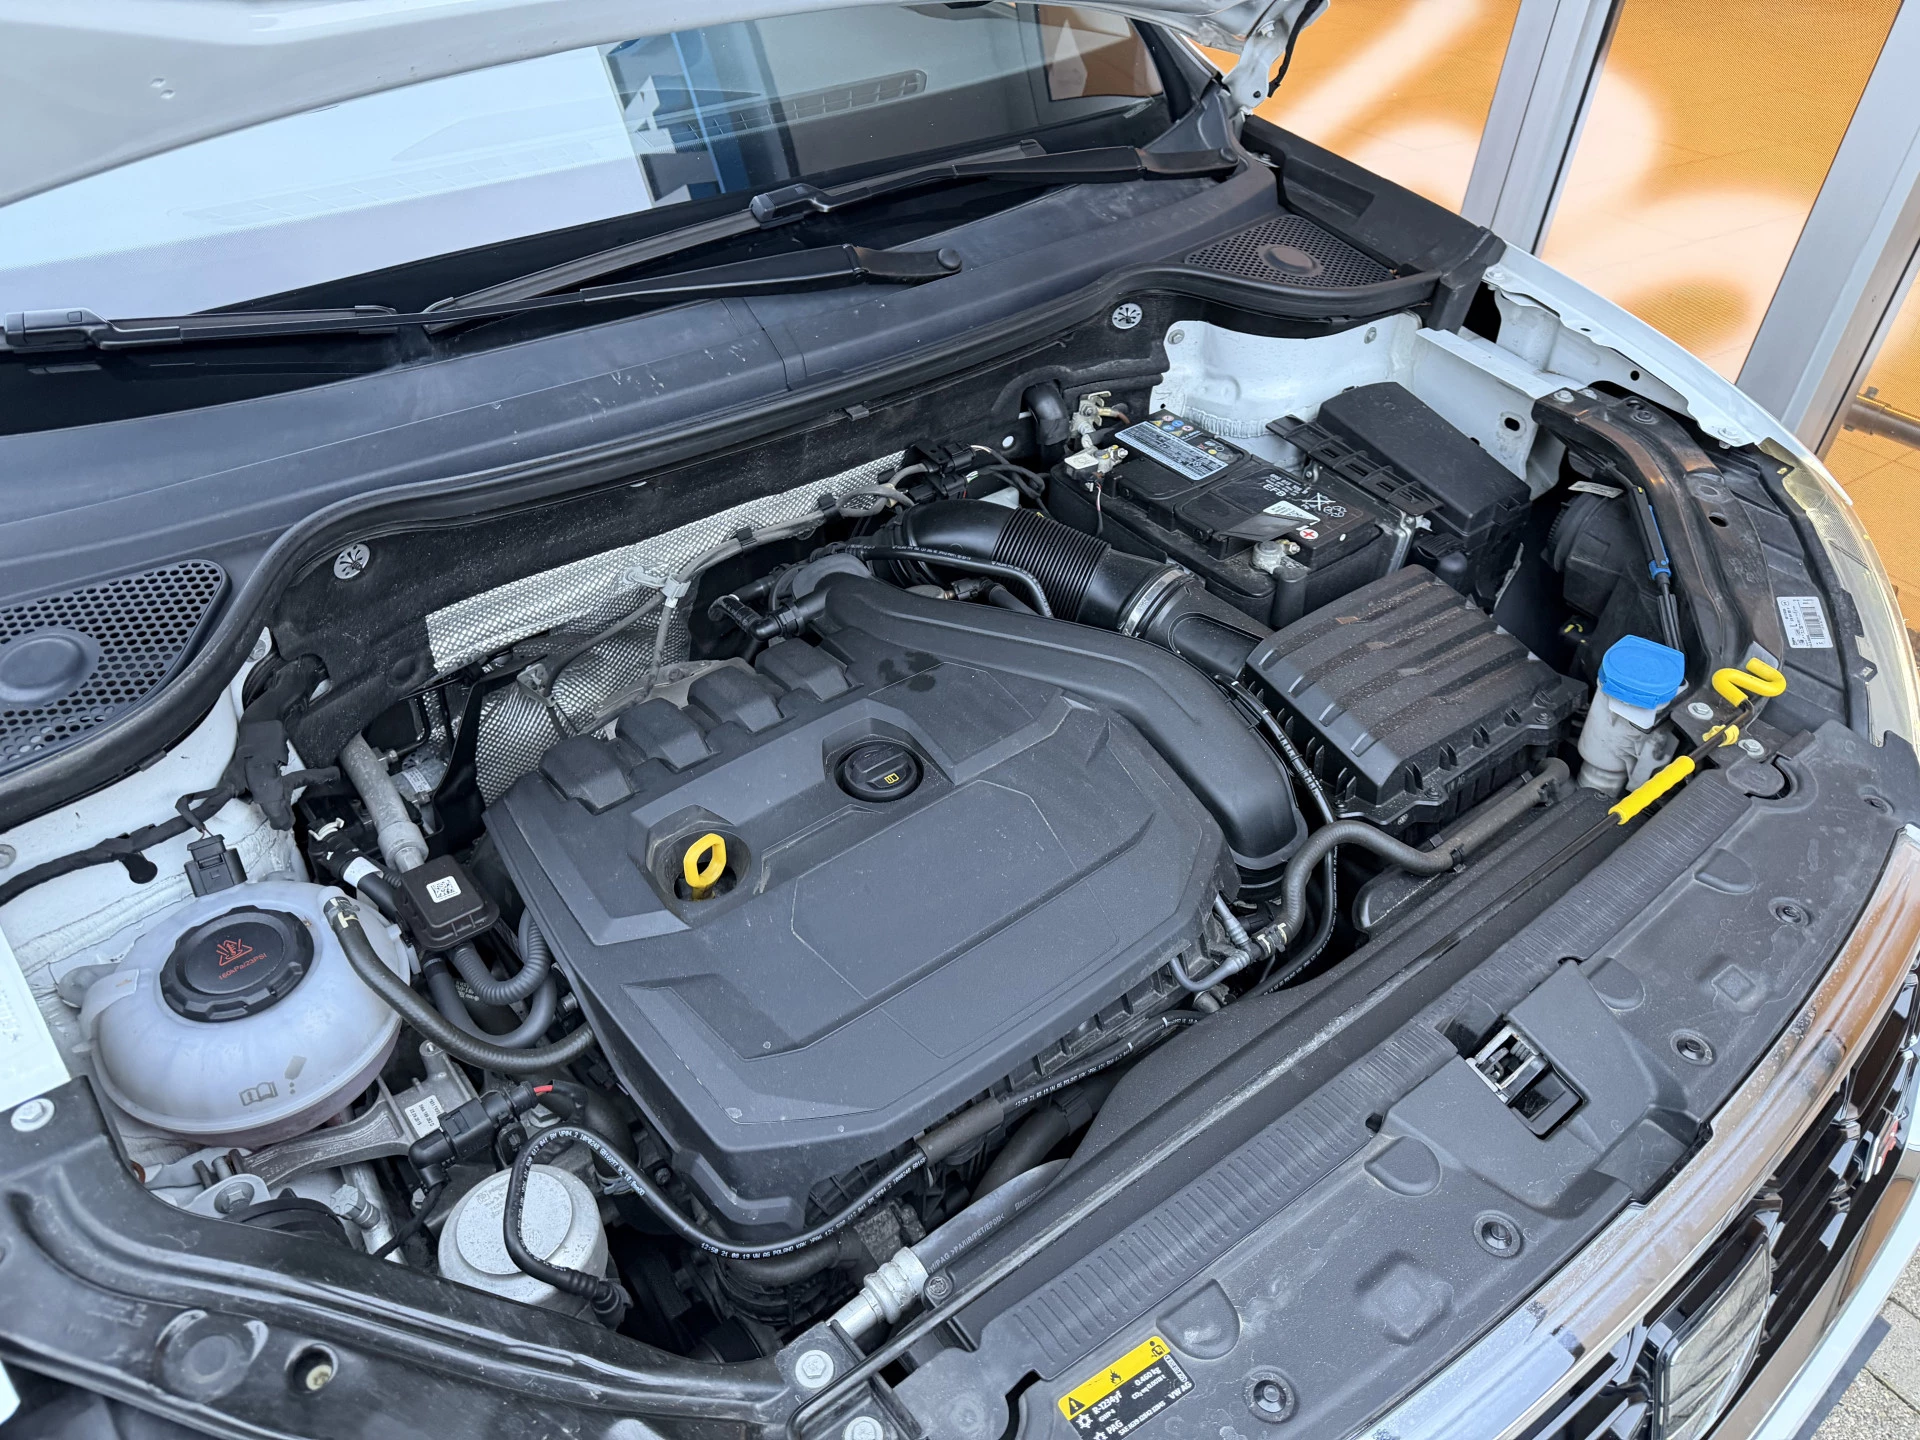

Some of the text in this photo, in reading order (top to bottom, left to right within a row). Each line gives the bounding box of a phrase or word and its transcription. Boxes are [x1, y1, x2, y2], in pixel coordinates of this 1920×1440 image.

[1263, 484, 1286, 496] EFB
[772, 1246, 794, 1256] POLAND
[1092, 1390, 1122, 1415] R-1234yf
[1151, 1367, 1162, 1376] kg
[1167, 1381, 1192, 1400] VW AG
[1106, 1420, 1124, 1434] PAG
[1118, 1427, 1129, 1436] SAE
